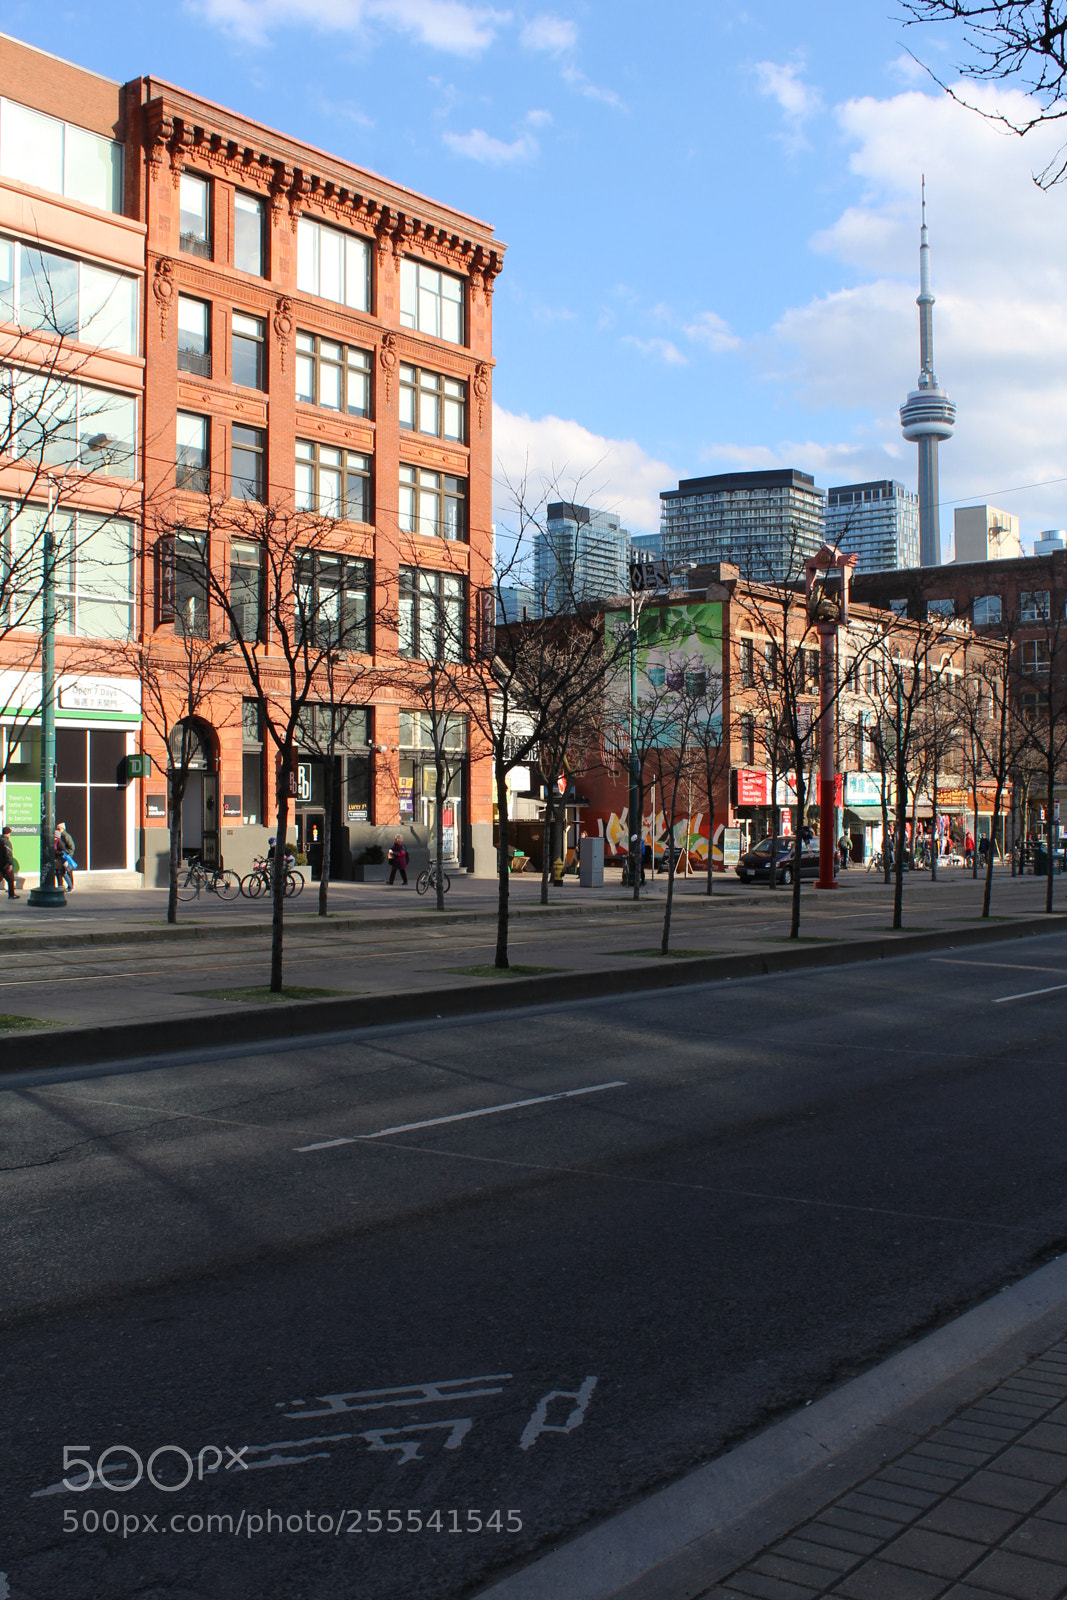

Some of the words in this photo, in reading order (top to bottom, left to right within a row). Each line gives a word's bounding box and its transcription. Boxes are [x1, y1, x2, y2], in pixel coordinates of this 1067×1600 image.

[72, 687, 92, 696] Open
[100, 688, 118, 698] Days
[130, 759, 142, 773] TD
